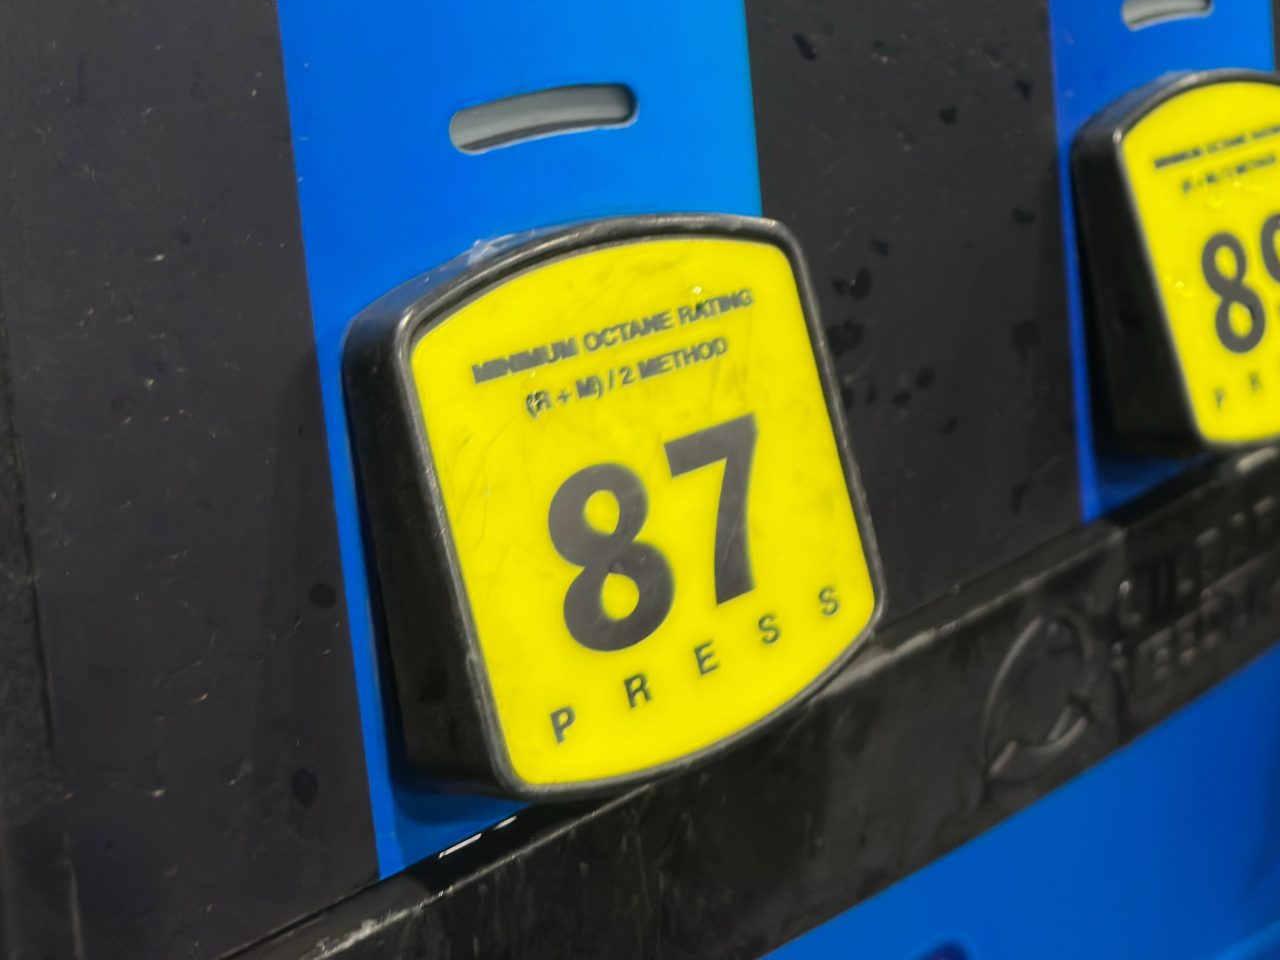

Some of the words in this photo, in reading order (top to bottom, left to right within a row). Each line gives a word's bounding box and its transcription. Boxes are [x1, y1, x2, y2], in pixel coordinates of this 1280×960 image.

[472, 336, 579, 384] MINIMUM
[583, 311, 674, 353] OCTANE
[677, 288, 754, 326] RATING
[620, 366, 635, 386] 2
[638, 336, 729, 380] METHOD
[548, 411, 760, 653] 87
[549, 586, 842, 744] PRESS
